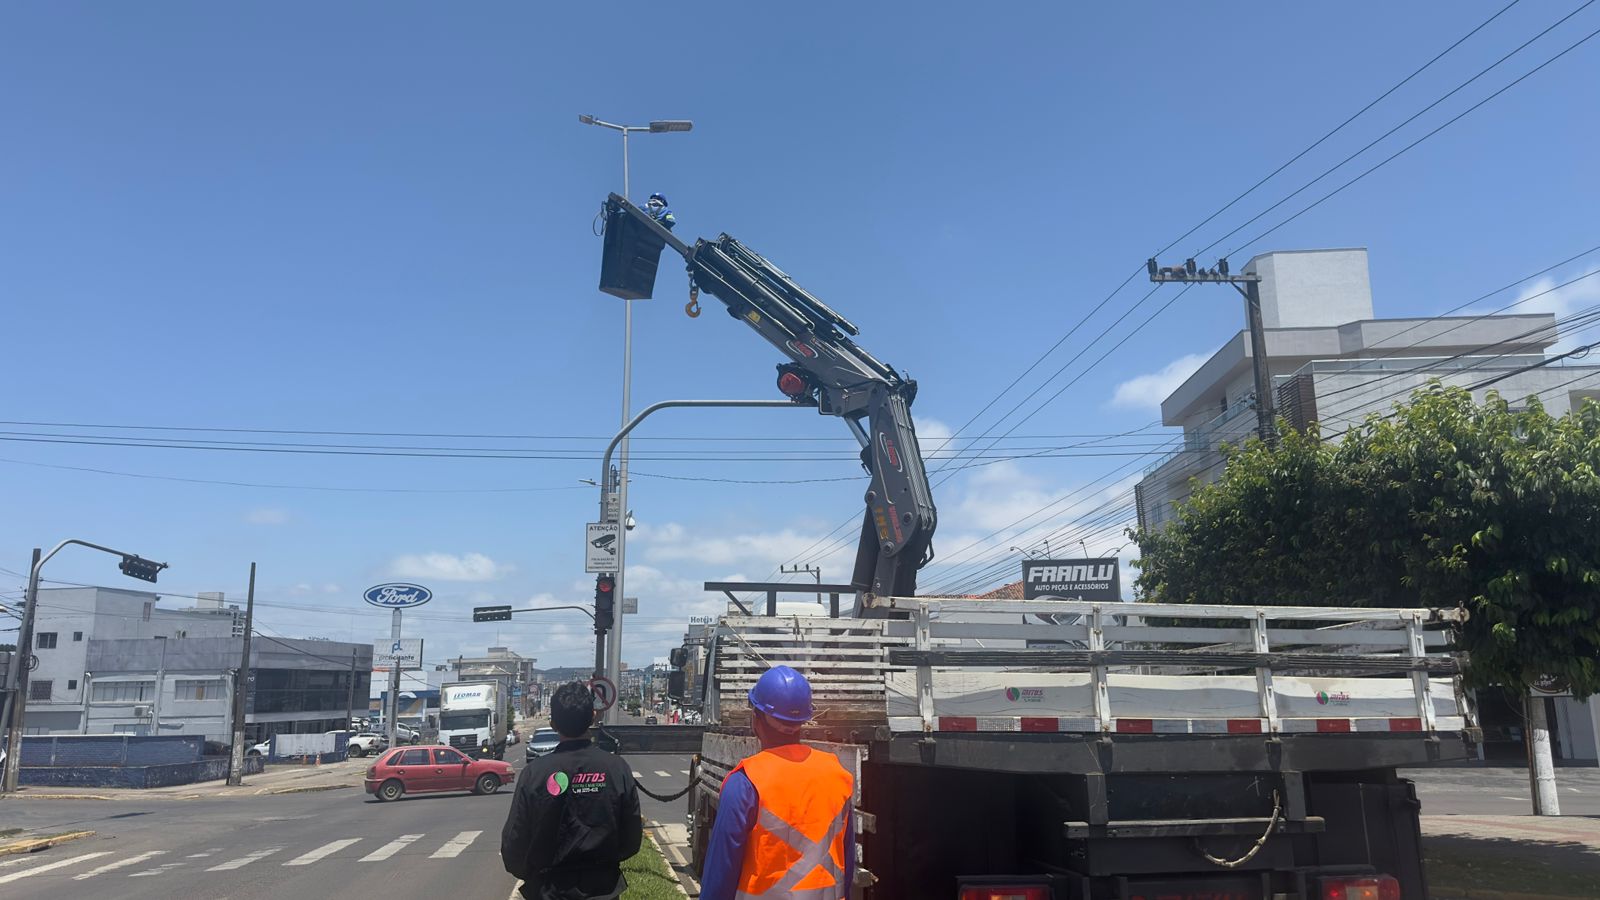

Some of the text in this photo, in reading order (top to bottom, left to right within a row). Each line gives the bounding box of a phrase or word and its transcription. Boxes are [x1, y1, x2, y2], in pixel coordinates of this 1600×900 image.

[1027, 564, 1114, 582] FRANLU
[1051, 584, 1068, 592] PEÇAS
[1074, 582, 1109, 590] ACESSÓRIOS
[378, 586, 419, 603] Ford
[572, 773, 606, 783] MITOS
